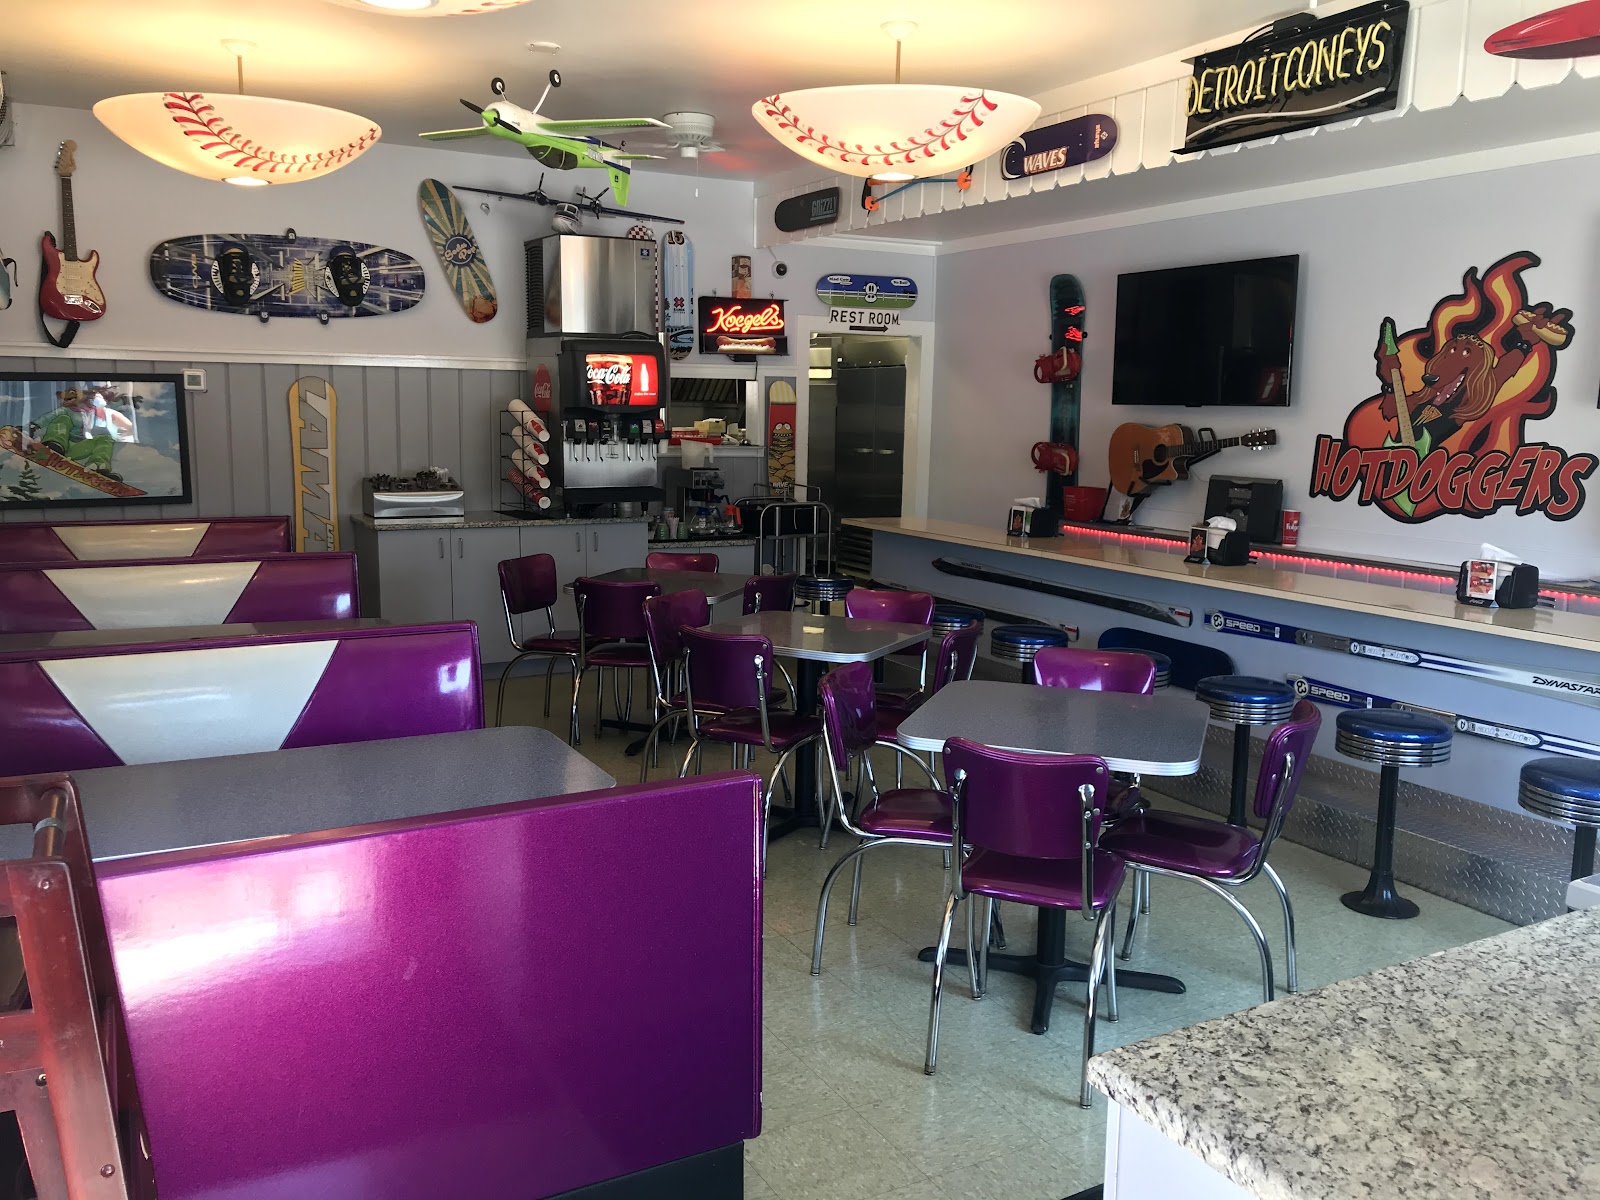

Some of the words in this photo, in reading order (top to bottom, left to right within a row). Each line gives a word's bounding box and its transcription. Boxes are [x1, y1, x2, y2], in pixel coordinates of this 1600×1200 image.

[1024, 146, 1067, 174] WAVES
[667, 230, 685, 245] 15
[706, 303, 785, 334] Koegel's
[831, 310, 865, 323] REST
[869, 312, 899, 325] ROOM
[1313, 436, 1594, 516] HOTDOGGERS
[1225, 619, 1261, 633] SPEED
[1310, 686, 1351, 702] SPEED
